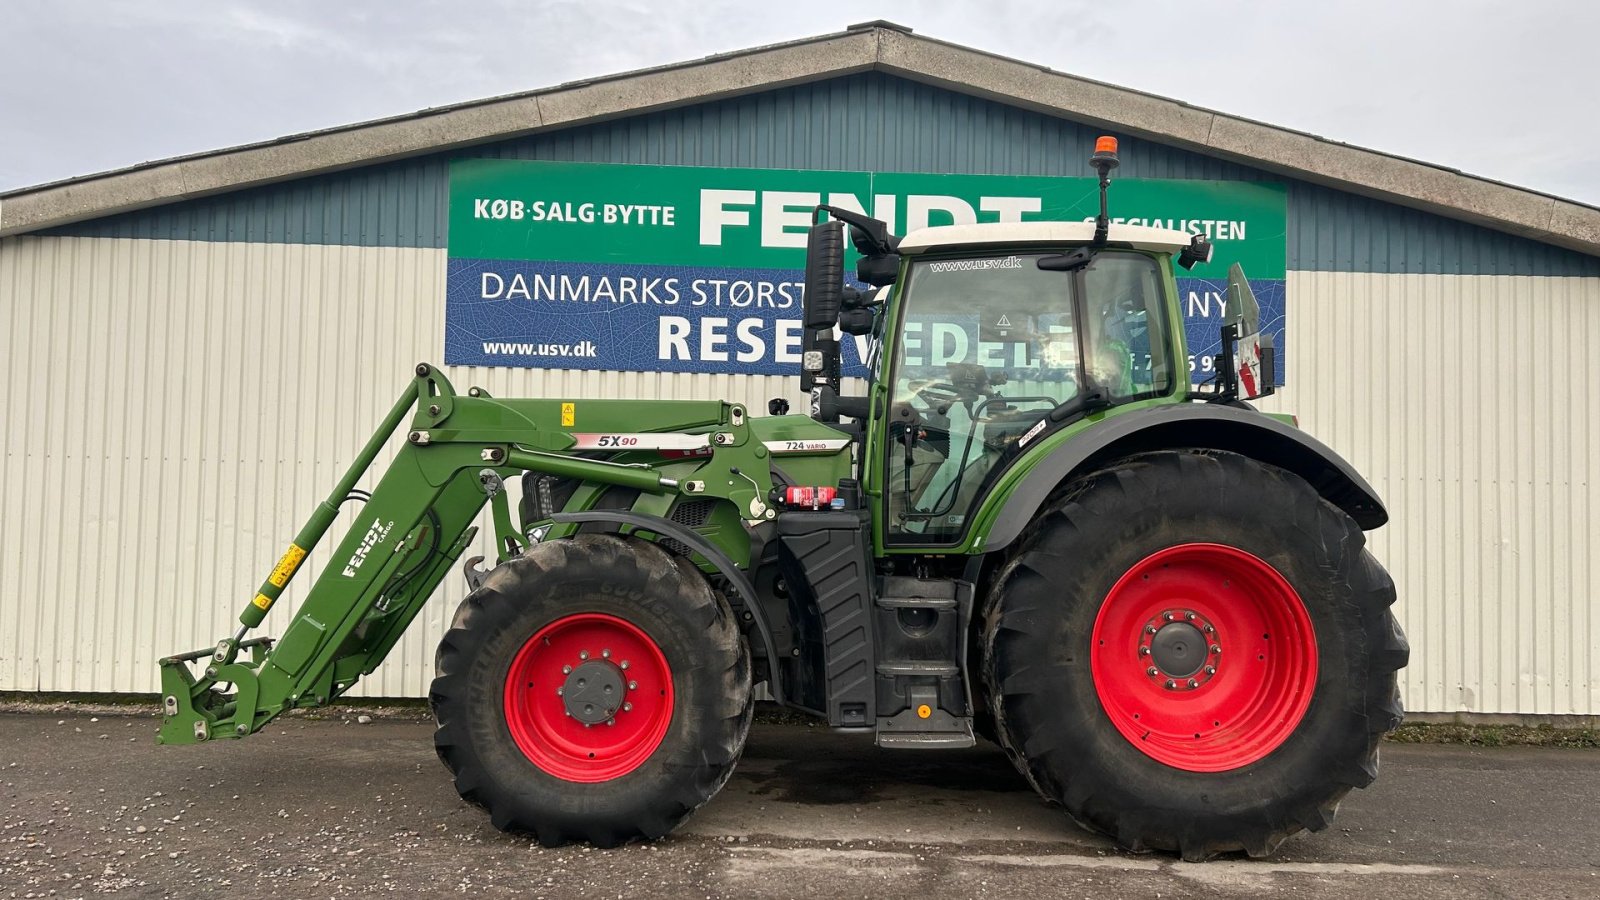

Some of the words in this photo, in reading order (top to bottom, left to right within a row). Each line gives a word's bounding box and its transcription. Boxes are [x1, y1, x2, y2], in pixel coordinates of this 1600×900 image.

[929, 255, 1023, 273] www.usv.dk
[480, 271, 680, 306] DANMARKS
[691, 279, 806, 309] STØRST
[482, 340, 597, 358] www.usv.dk
[785, 441, 805, 450] 724
[378, 520, 395, 543] CARGO
[341, 517, 385, 578] FENDT
